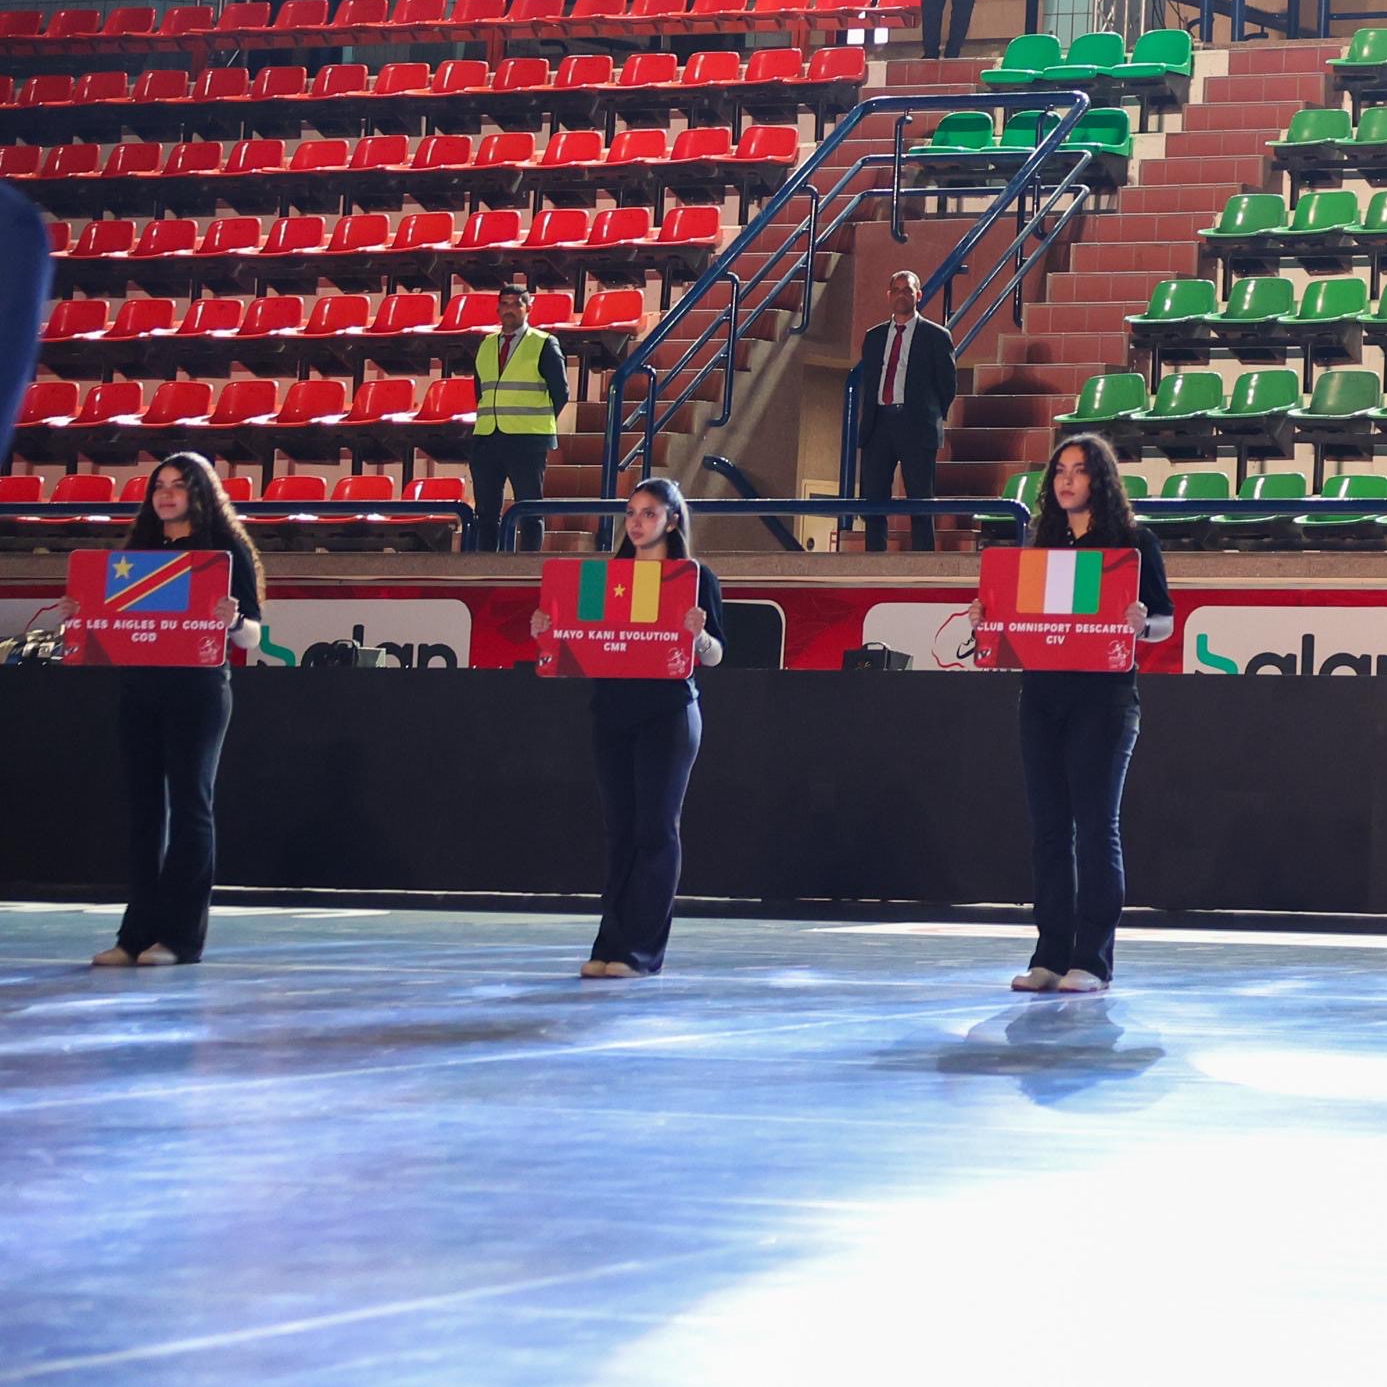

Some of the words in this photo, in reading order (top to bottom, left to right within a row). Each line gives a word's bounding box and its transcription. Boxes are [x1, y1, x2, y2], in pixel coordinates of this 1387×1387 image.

[87, 620, 108, 629] LES
[113, 620, 155, 630] AIGLES
[160, 620, 177, 630] DU
[182, 620, 225, 630] CONGO
[977, 622, 1004, 631] CLUB
[1009, 623, 1071, 633] OMNISPORT
[1076, 624, 1135, 634] DESCARTES
[553, 630, 584, 639] MAYO
[588, 630, 615, 640] KANI
[619, 631, 679, 641] EVOLUTION
[1046, 635, 1065, 645] CIV
[603, 642, 627, 652] CMR
